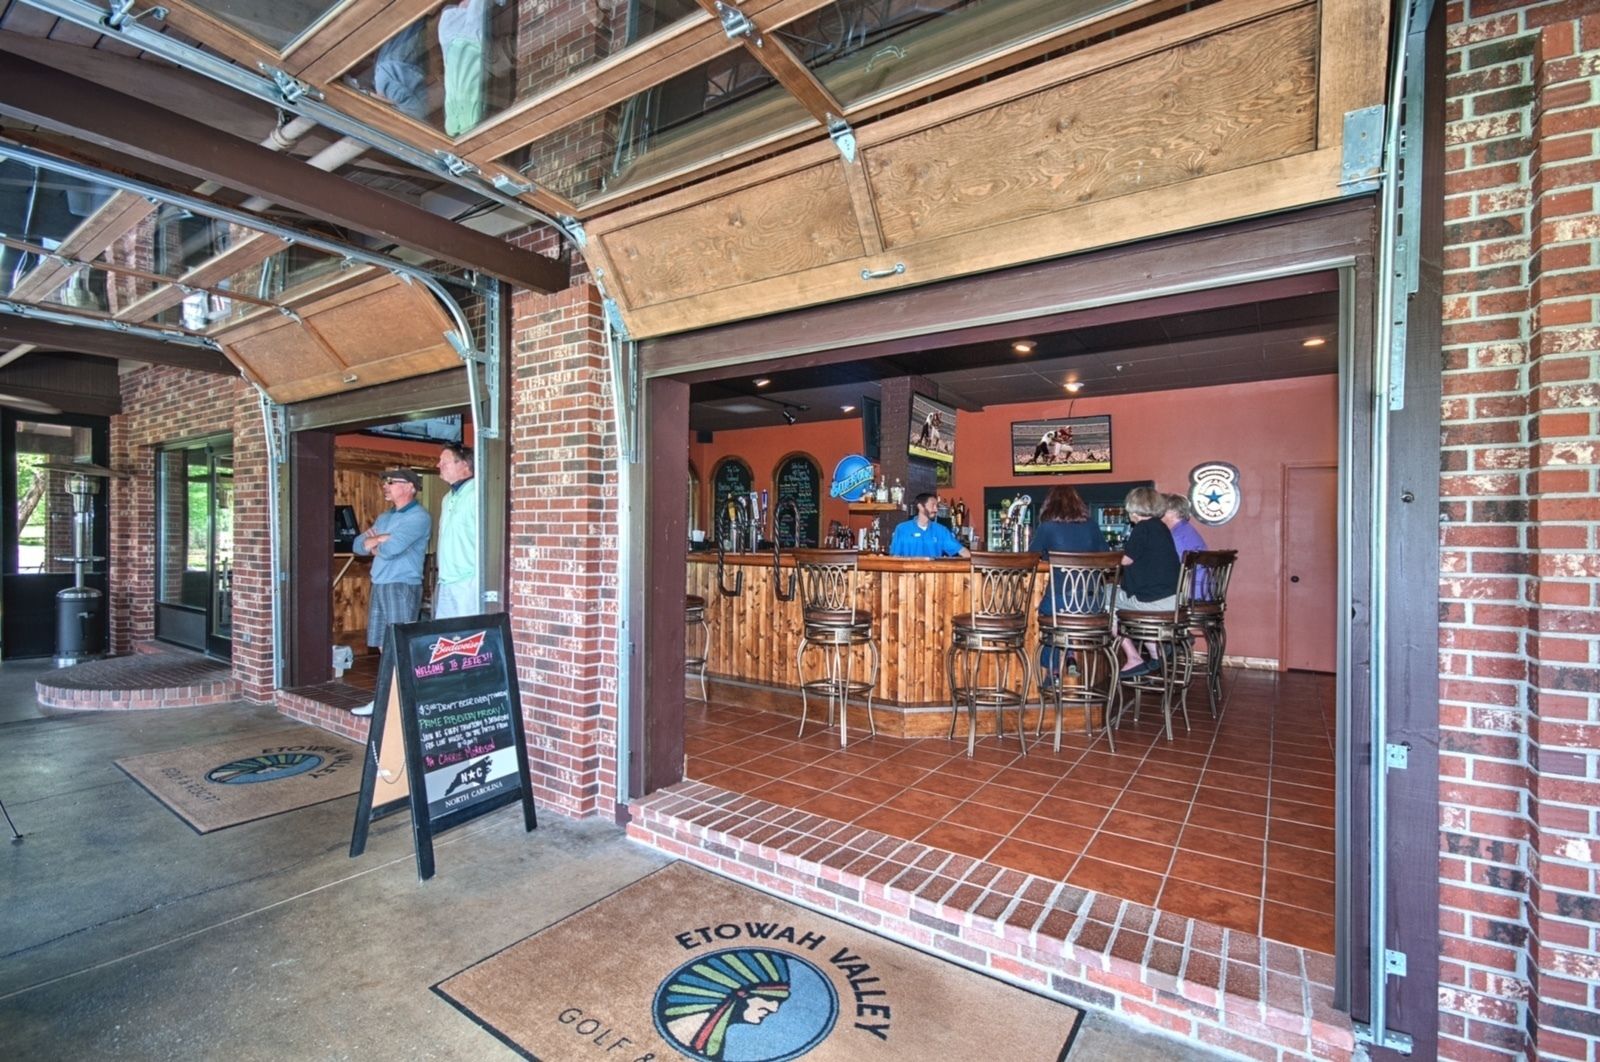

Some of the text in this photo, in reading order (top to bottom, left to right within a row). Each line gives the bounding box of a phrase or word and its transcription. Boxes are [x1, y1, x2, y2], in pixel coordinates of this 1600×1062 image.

[429, 641, 484, 656] Budweiser
[415, 663, 445, 678] WELCOME
[449, 659, 459, 670] TO
[418, 718, 442, 729] PRIME
[445, 781, 504, 809] NORTH CAROLINA
[675, 922, 892, 1042] ETOWAH VALLEY
[558, 1007, 632, 1052] GOLF
